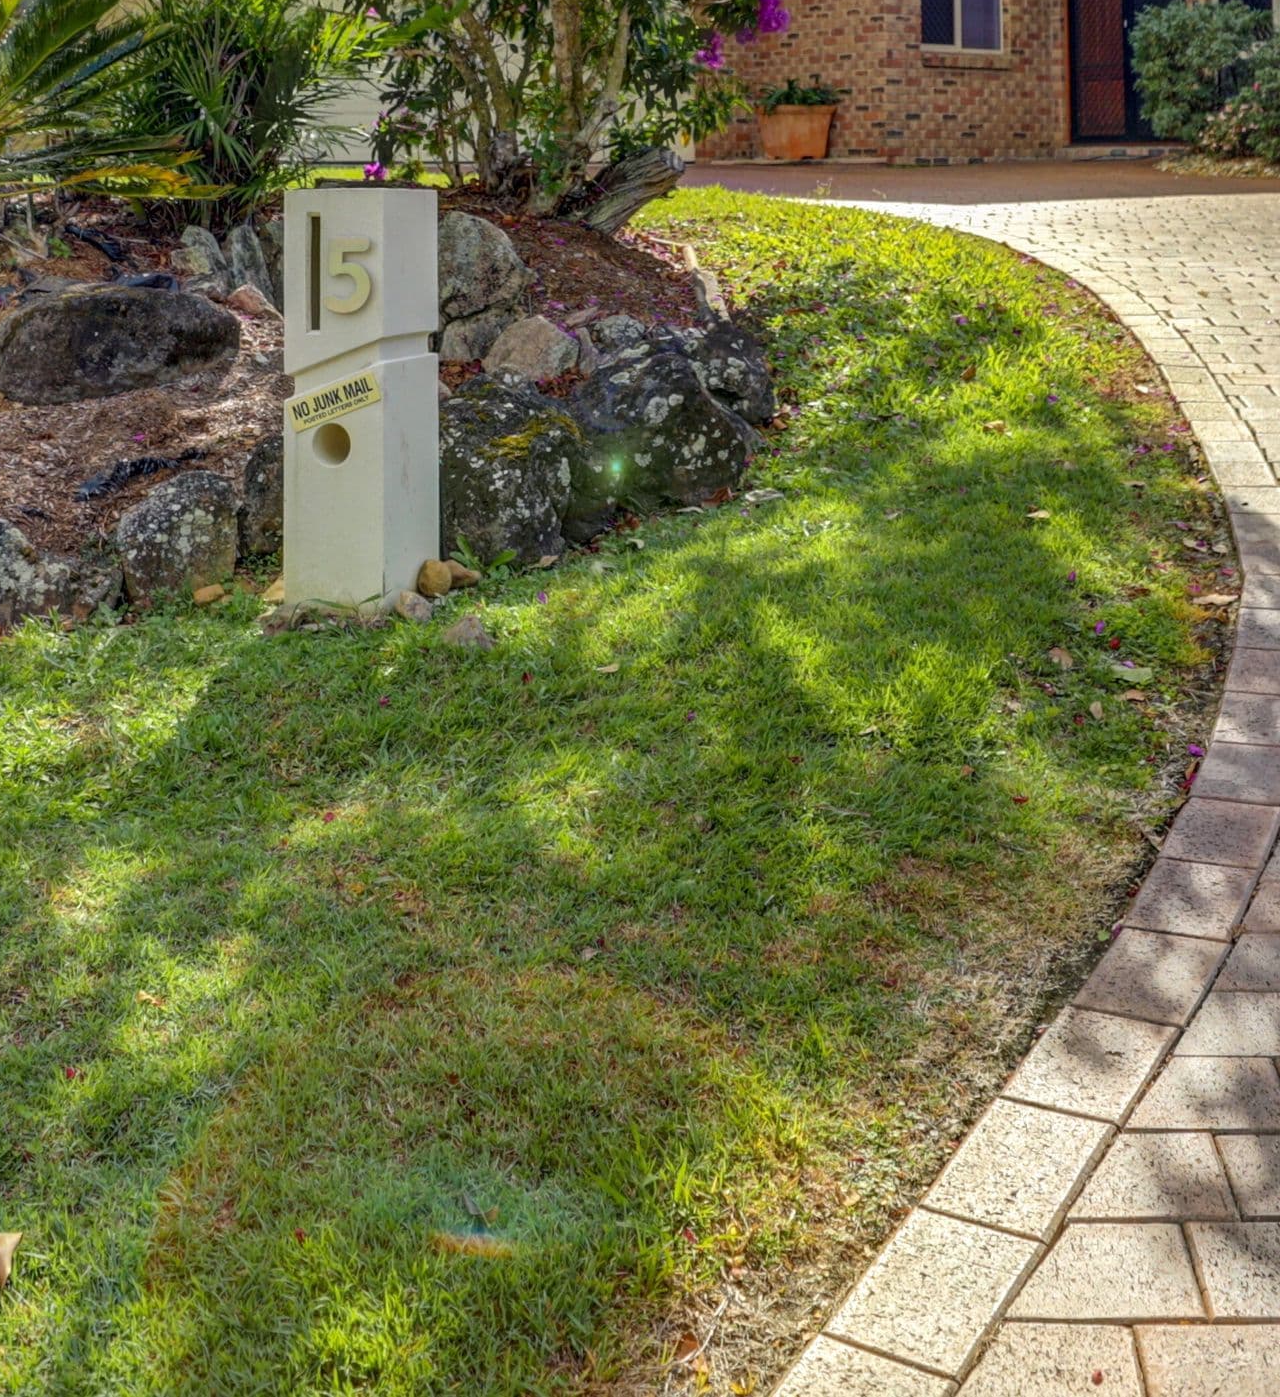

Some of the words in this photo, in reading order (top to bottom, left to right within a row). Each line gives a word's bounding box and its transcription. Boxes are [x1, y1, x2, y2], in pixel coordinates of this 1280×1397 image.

[325, 237, 371, 313] 5
[292, 401, 310, 420] NO
[313, 388, 343, 413] JUNK
[342, 377, 373, 400] MAIL
[303, 411, 327, 425] POSTED
[327, 402, 352, 416] LETTERS
[353, 395, 369, 406] ONLY
